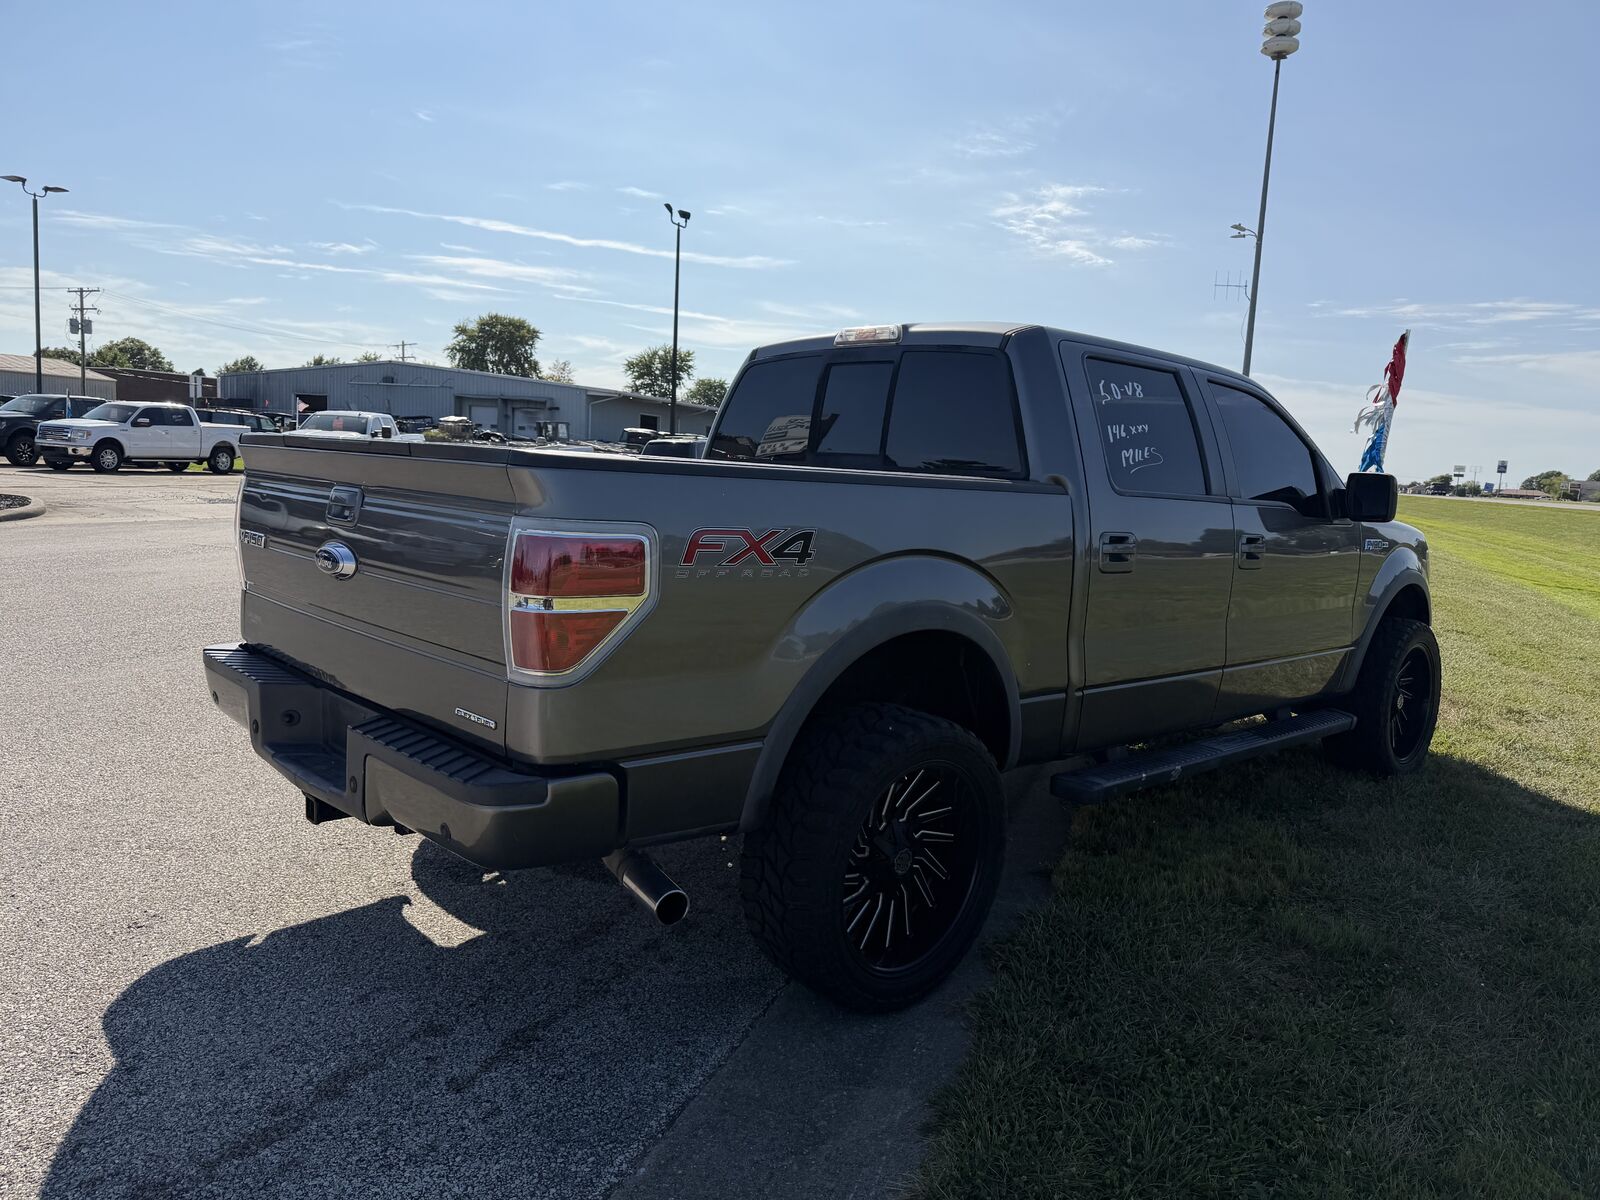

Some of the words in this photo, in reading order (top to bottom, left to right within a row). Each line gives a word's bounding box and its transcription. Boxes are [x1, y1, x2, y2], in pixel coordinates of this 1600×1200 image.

[678, 526, 818, 567] FX4
[675, 569, 730, 578] OFF
[741, 568, 809, 578] ROAD
